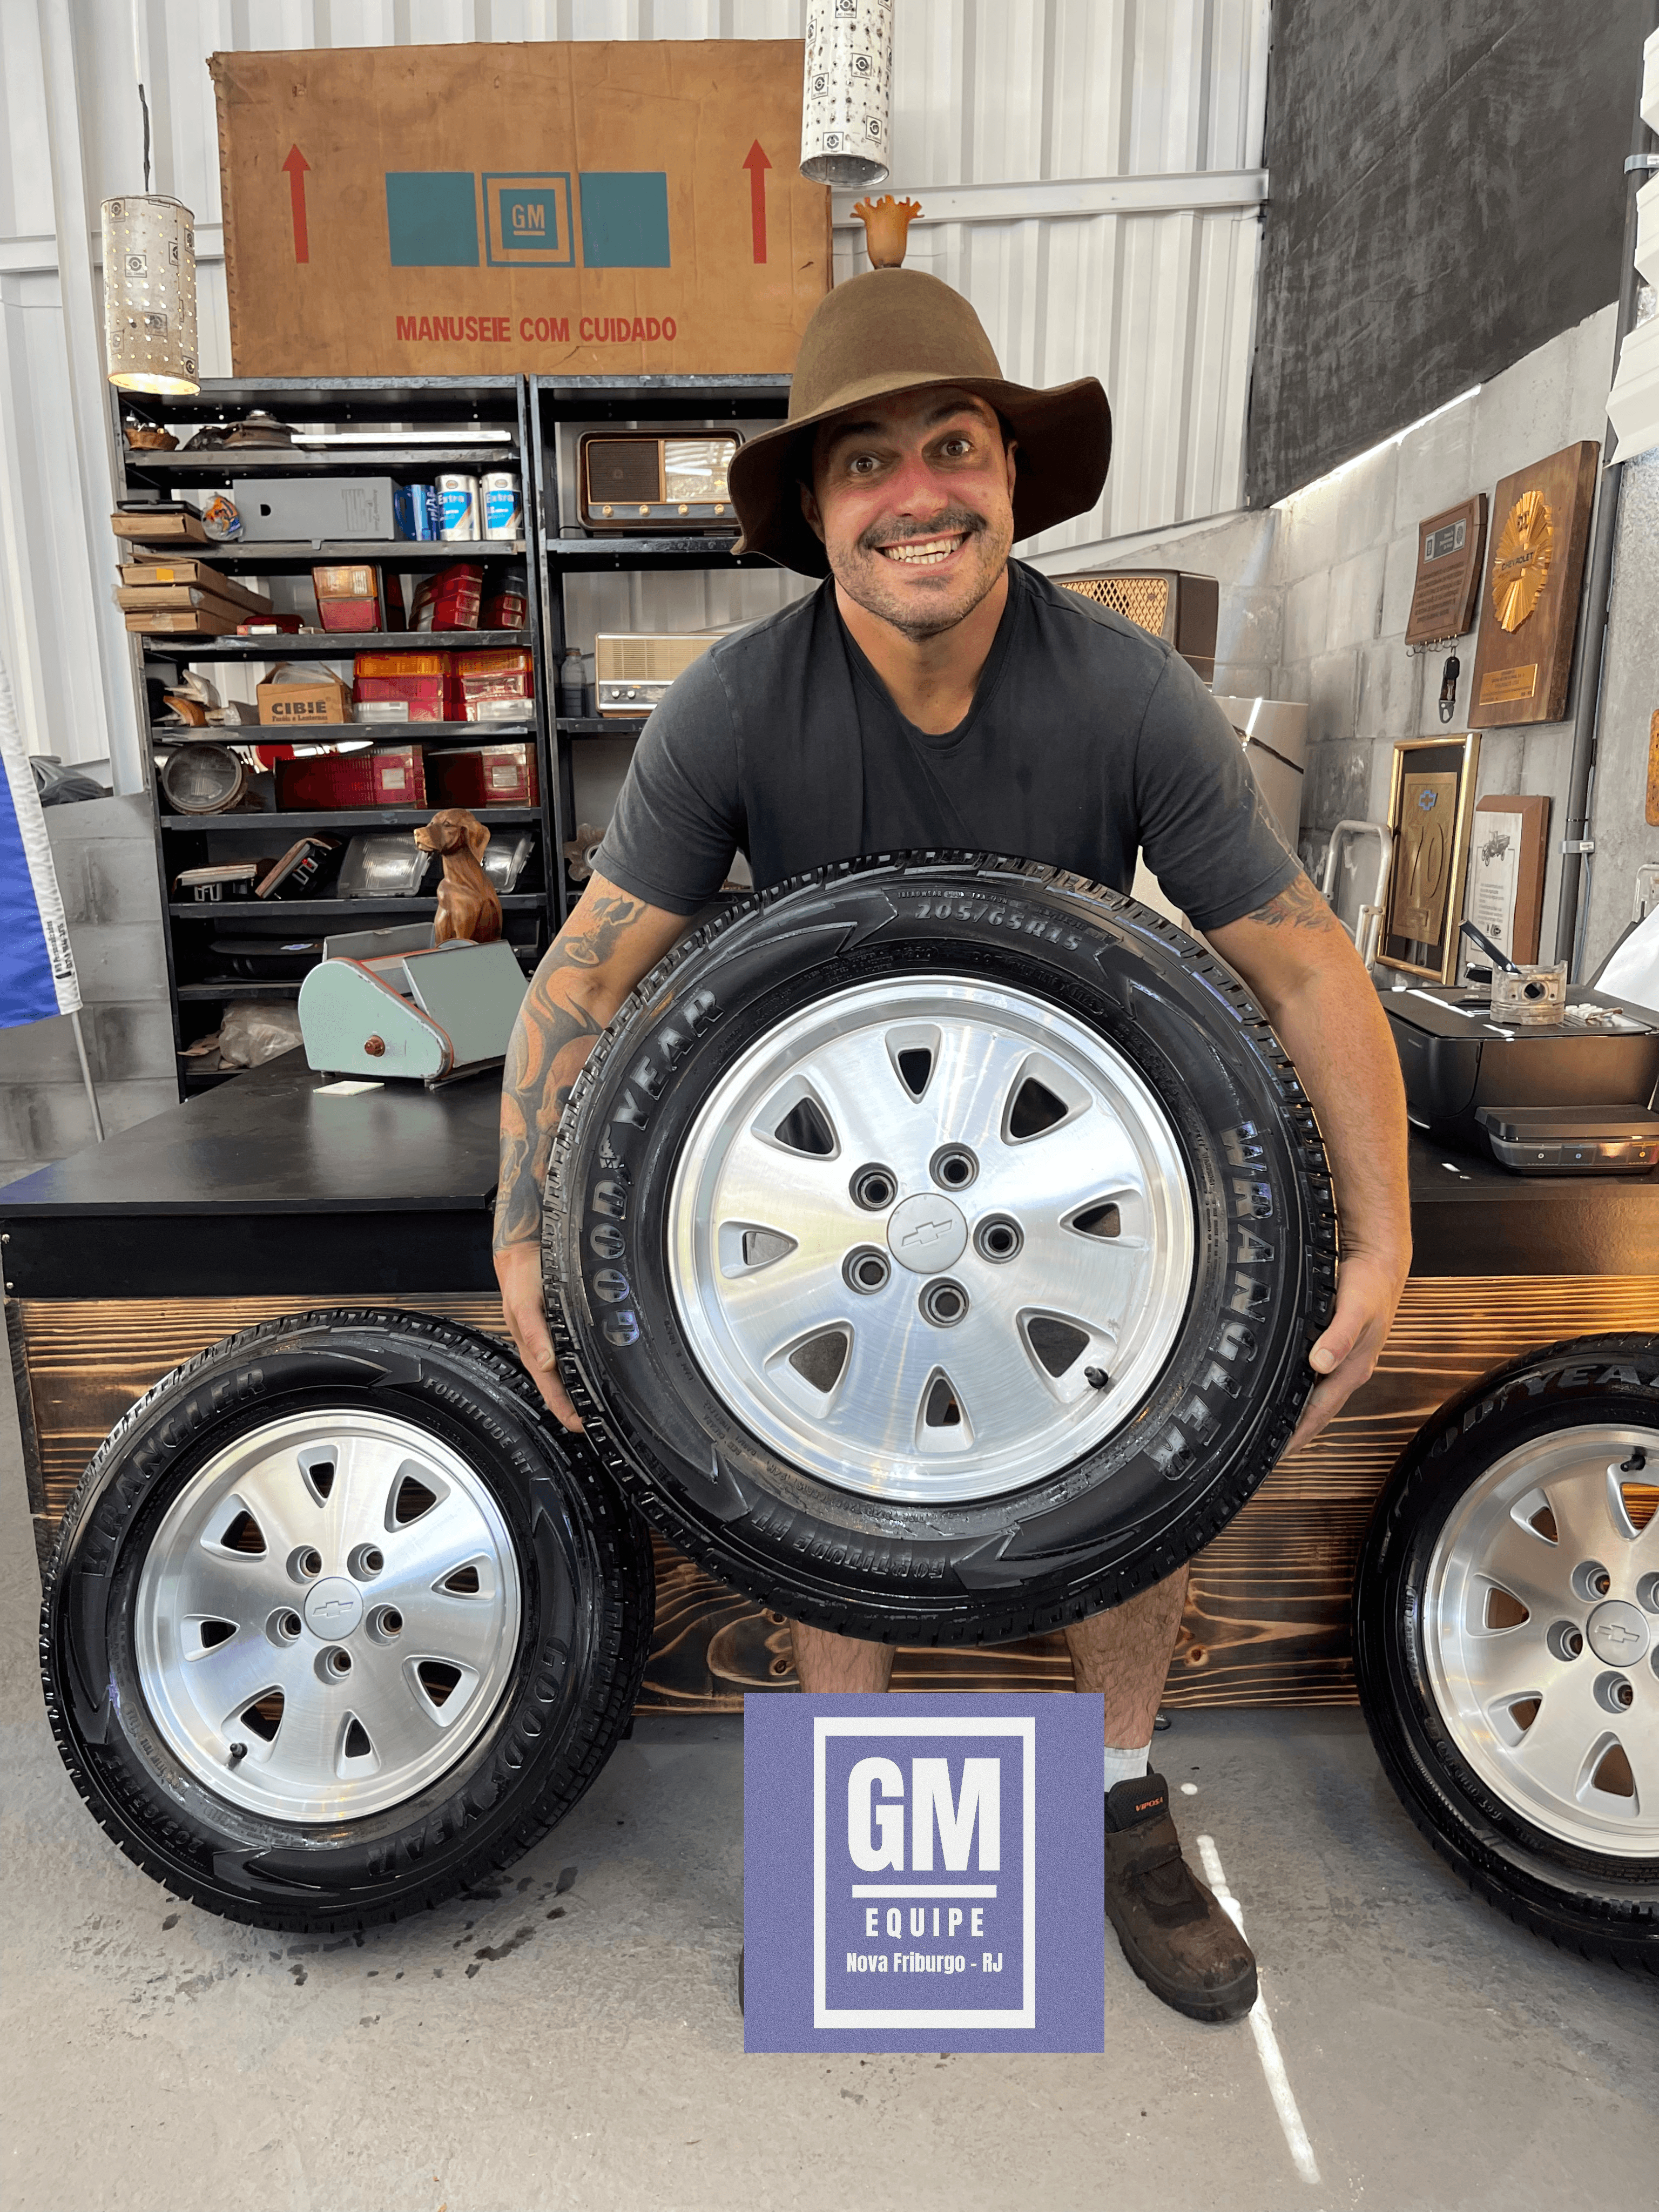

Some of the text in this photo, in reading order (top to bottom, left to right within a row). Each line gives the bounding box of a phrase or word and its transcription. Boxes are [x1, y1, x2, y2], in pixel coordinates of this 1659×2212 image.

[512, 204, 545, 229] GM
[396, 315, 677, 342] MANUSEIE COM CUIDADO
[438, 495, 464, 505] Extra
[487, 494, 514, 504] Extra
[1502, 552, 1534, 571] CHEVROLET
[898, 891, 942, 899] TREADWEAR
[972, 892, 1008, 904] TRACTION
[915, 903, 1082, 950] 205/65R15
[1143, 1120, 1275, 1481] WRANGLER
[1524, 1364, 1659, 1395] YEA
[422, 1376, 533, 1475] FORTITUDE HT
[80, 1368, 266, 1577] WRANGLER
[751, 1515, 946, 1579] FORTITUDE HT
[367, 1637, 568, 1877] GOOD YEAR
[107, 1756, 204, 1853] 205/65R15
[1135, 1797, 1163, 1812] VIPOSA
